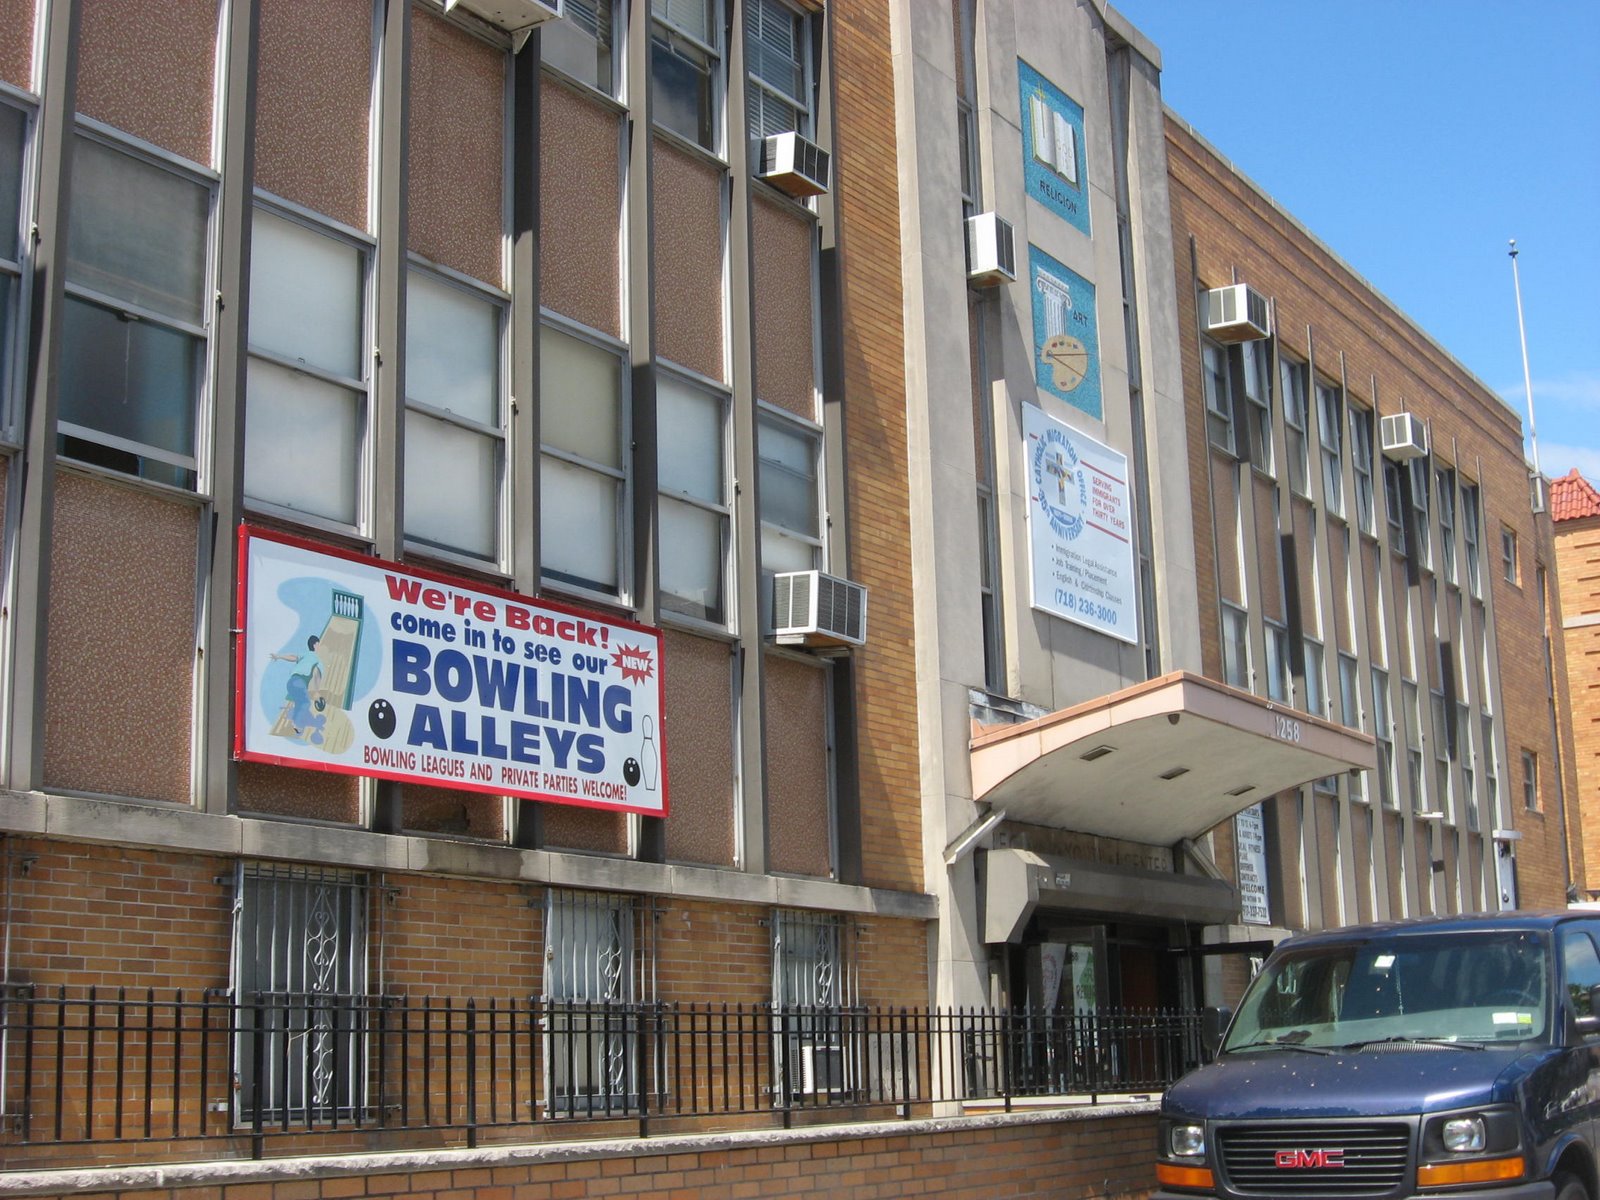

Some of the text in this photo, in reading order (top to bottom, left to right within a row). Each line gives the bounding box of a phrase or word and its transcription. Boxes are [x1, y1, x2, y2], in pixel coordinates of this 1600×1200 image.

[1040, 179, 1077, 215] RELIGION
[1072, 309, 1088, 328] ART
[1034, 434, 1048, 485] CATHOLIC
[1046, 428, 1078, 465] MIGRATION
[1077, 469, 1087, 507] OFFICE
[1092, 476, 1112, 492] SERVING
[1092, 487, 1121, 506] IMMIGRANTS
[1092, 497, 1115, 513] FOR OVER
[1093, 508, 1125, 529] THIRTY YEARS
[1049, 513, 1084, 541] ANNIVERSARY
[1056, 570, 1072, 584] English
[385, 575, 609, 649] We're Back!
[1055, 588, 1117, 625] (718) 236-3000
[391, 611, 608, 675] come in to see our
[622, 655, 649, 672] NEW
[392, 639, 632, 734] BOWLING
[407, 703, 606, 774] ALLEYS
[1275, 714, 1300, 743] 1258
[364, 745, 627, 801] BOWLING LEAGUES AND PRIVATE PARTIES WELCOME!
[1275, 1149, 1344, 1168] GMC
